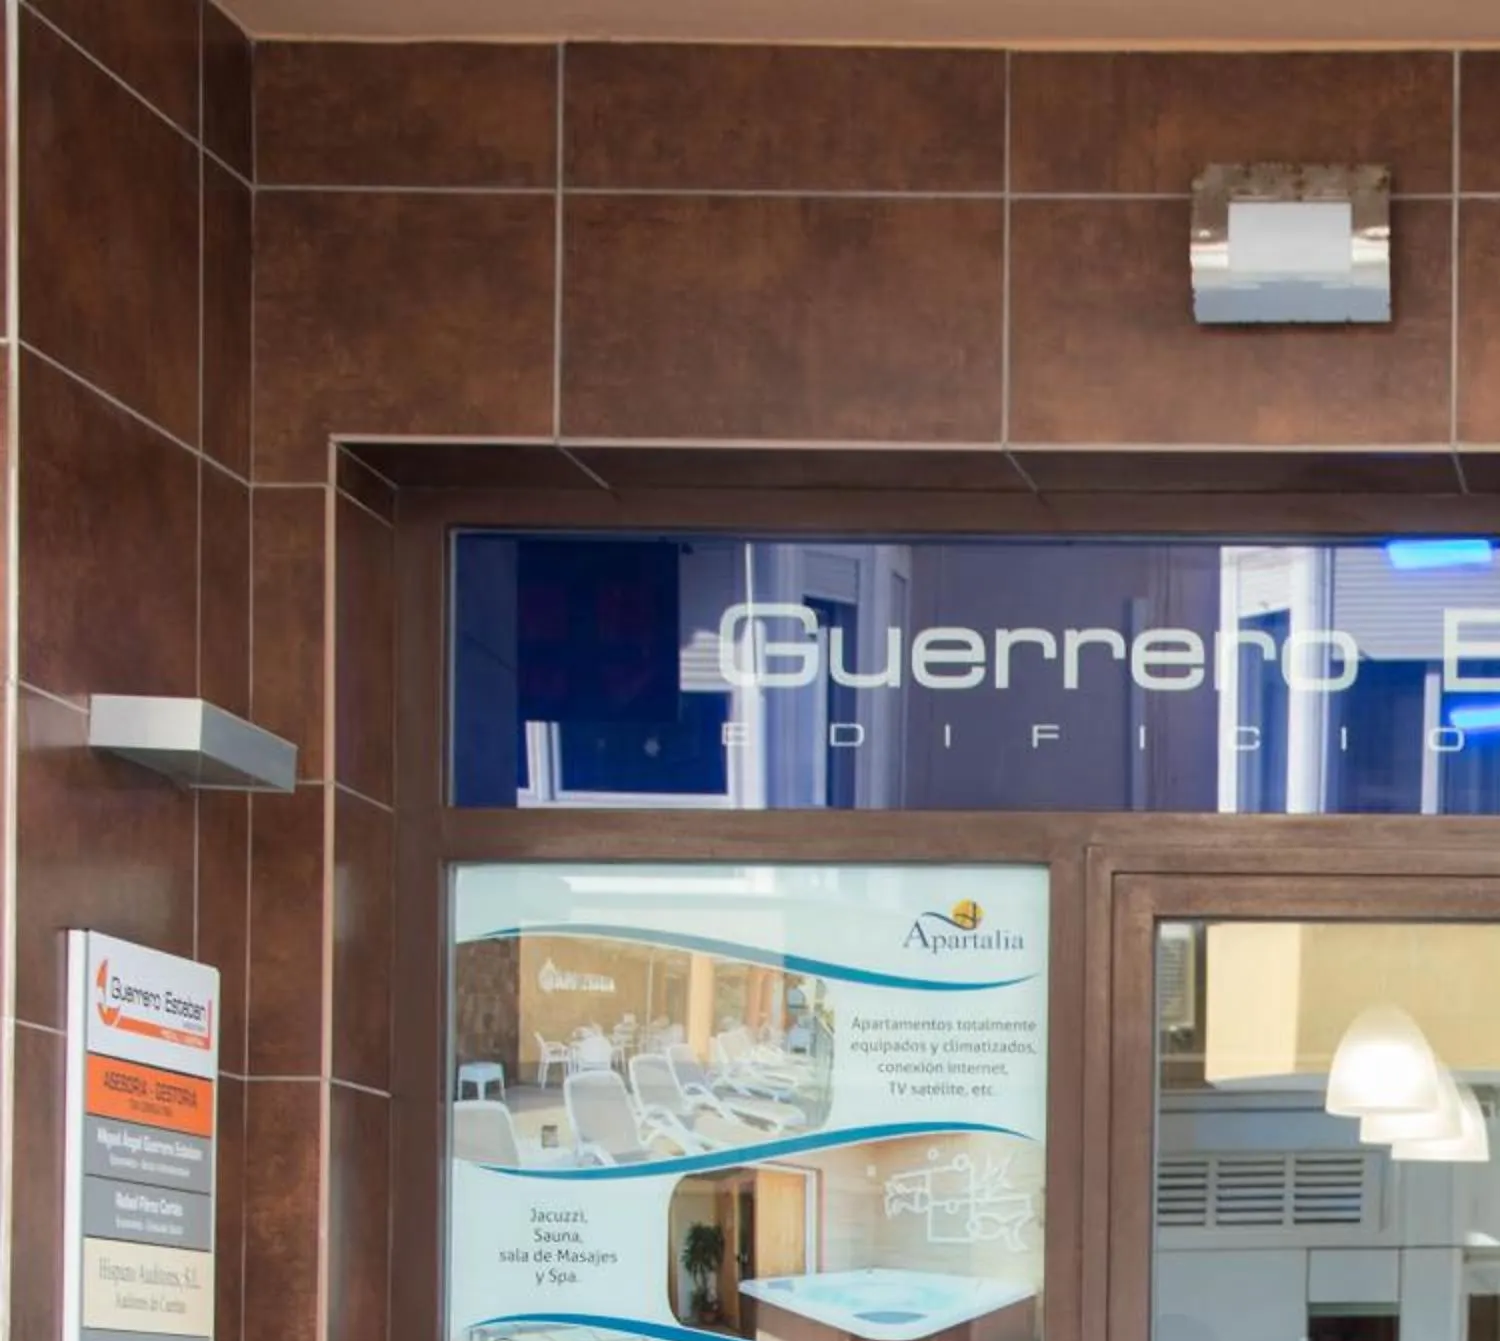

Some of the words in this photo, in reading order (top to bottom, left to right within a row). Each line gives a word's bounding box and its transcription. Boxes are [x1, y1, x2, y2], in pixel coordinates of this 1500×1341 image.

[718, 602, 1359, 690] Guerrero
[903, 919, 1025, 954] Apartalia
[851, 1016, 954, 1034] Apartamentos
[956, 1017, 1037, 1032] totalmente
[850, 1039, 926, 1056] equipados
[929, 1042, 939, 1056] y
[889, 1081, 907, 1096] TV
[529, 1207, 589, 1224] Jacuzzi,
[499, 1247, 529, 1263] sala
[533, 1248, 553, 1263] de
[556, 1248, 618, 1267] Masajes
[535, 1270, 546, 1286] y
